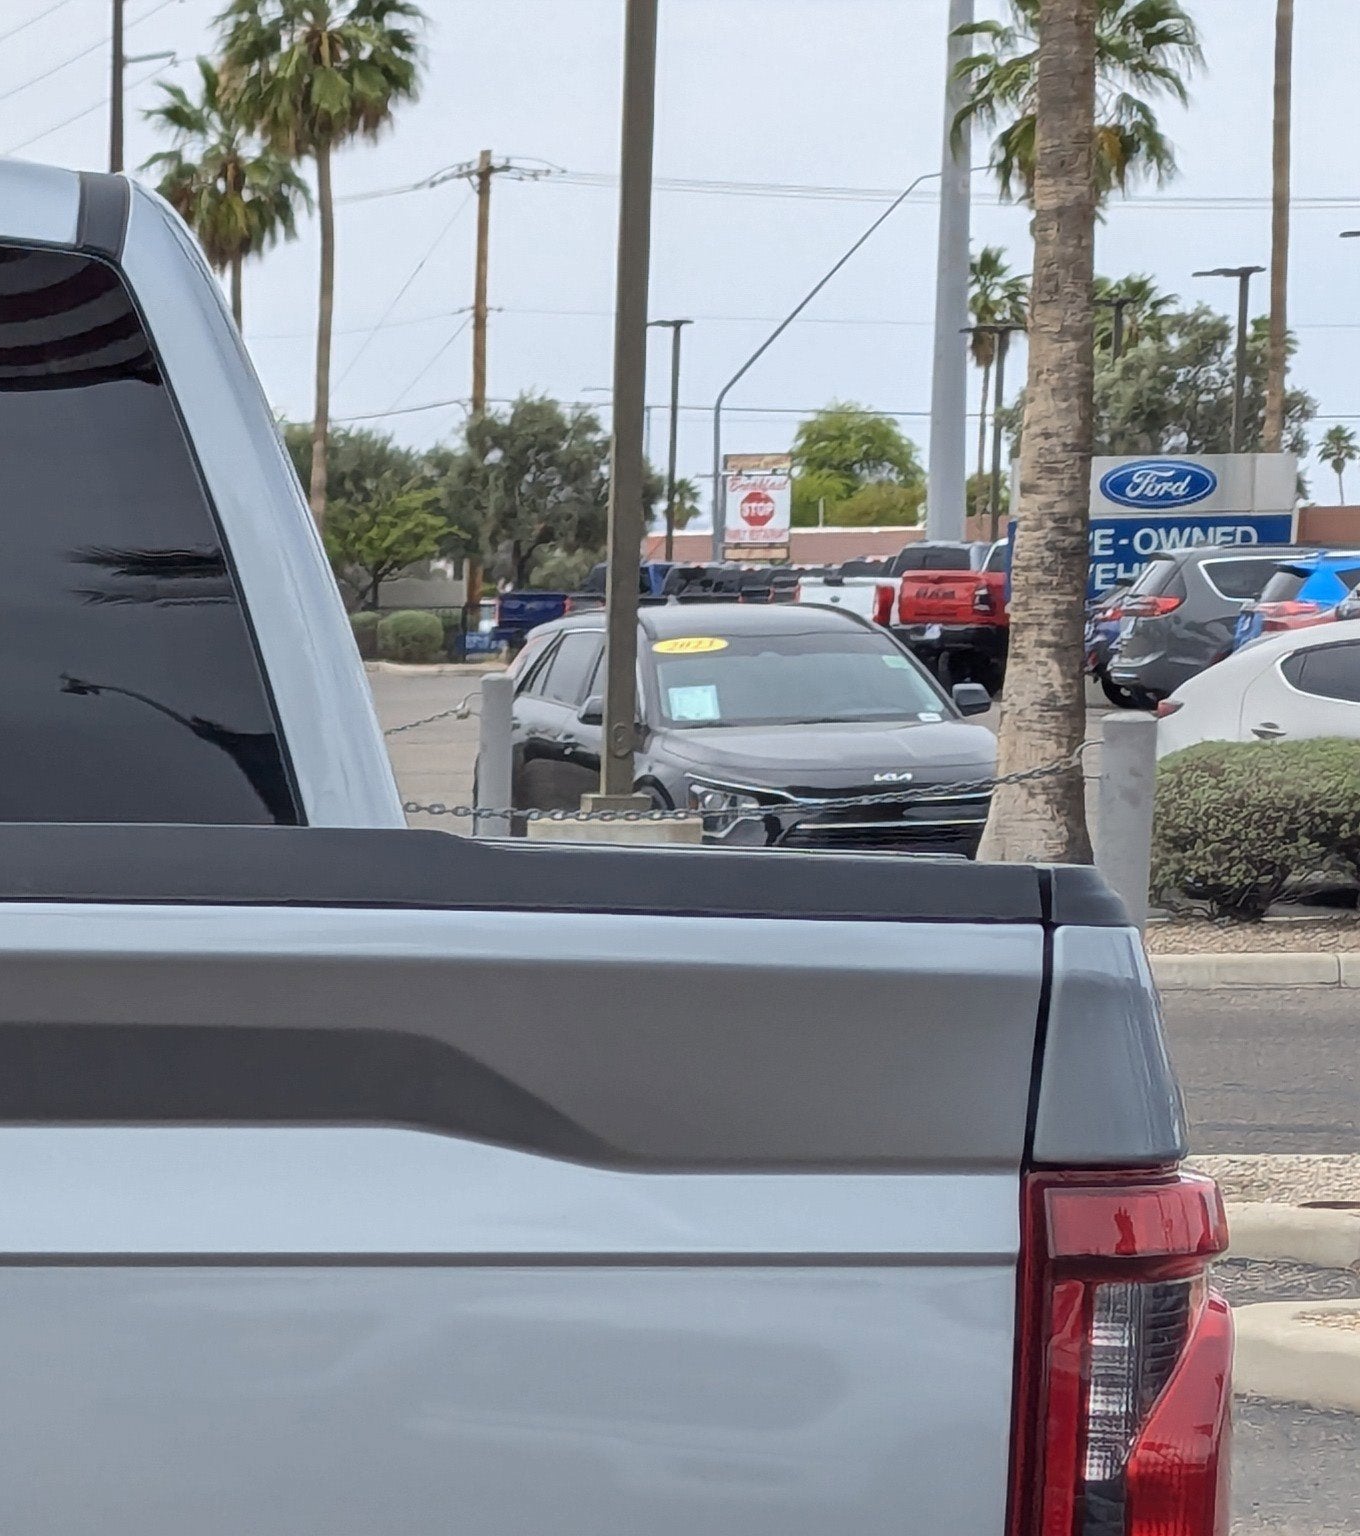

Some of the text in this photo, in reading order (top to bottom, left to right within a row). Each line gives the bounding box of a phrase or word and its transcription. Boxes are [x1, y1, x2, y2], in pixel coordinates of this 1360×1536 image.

[1125, 469, 1191, 498] Ford
[740, 502, 774, 516] STOP
[1089, 525, 1259, 555] E-OWNED
